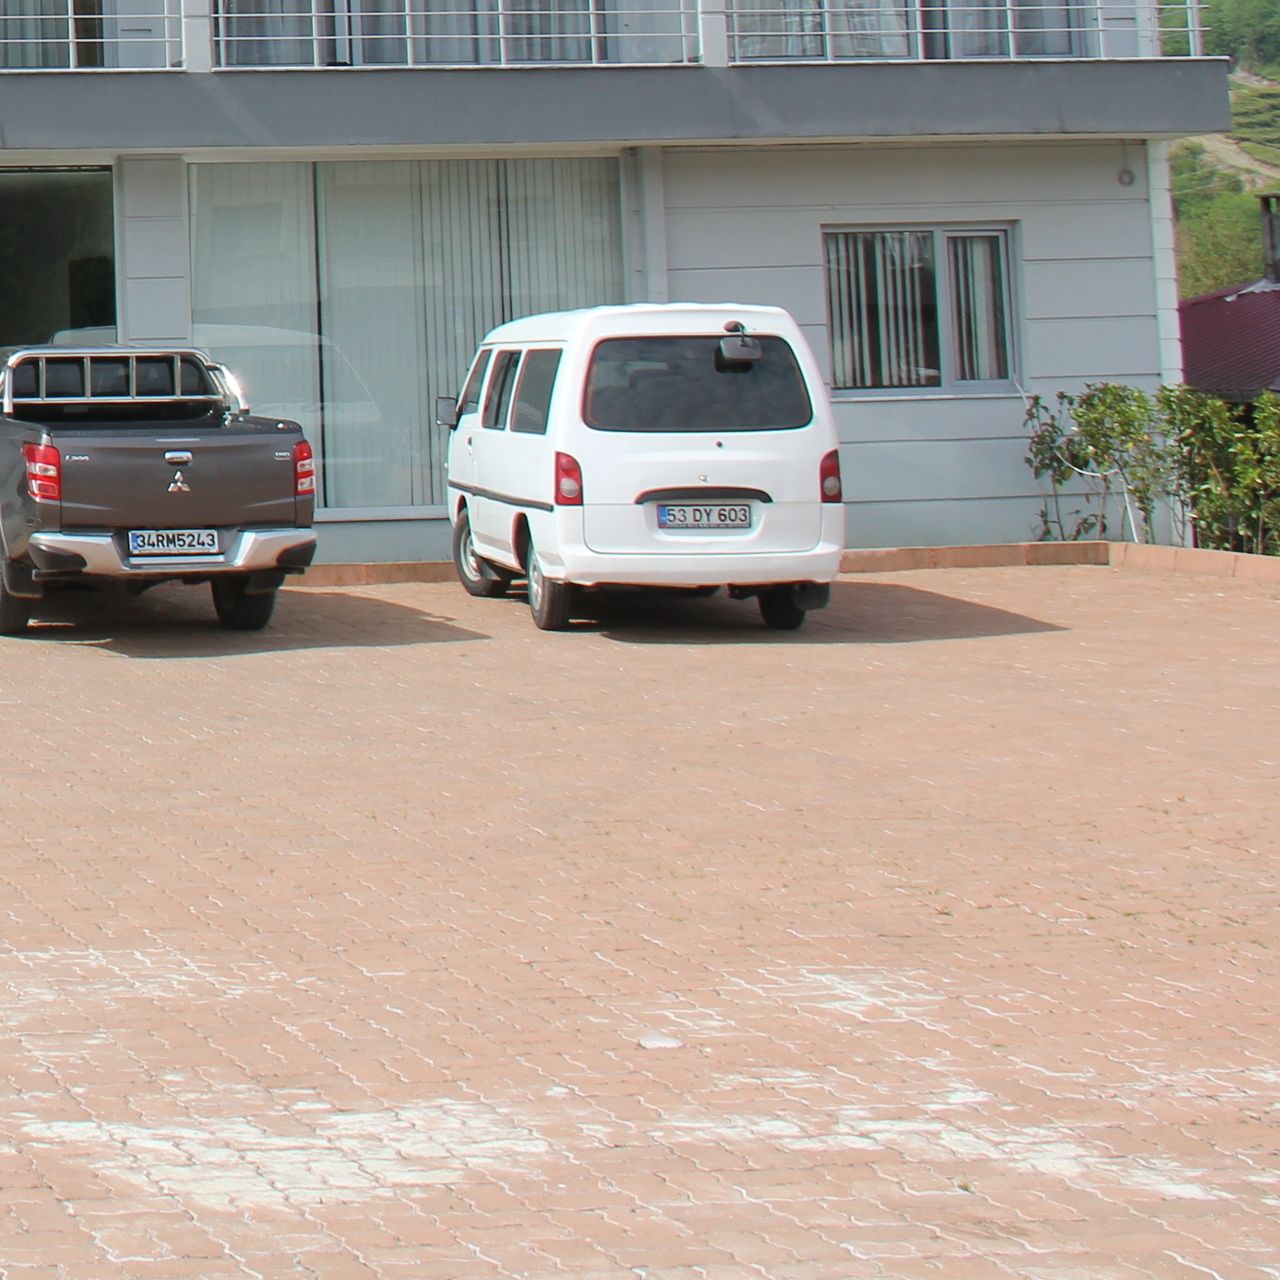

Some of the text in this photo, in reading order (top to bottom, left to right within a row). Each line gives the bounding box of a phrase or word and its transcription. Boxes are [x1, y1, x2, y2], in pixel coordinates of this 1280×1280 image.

[667, 508, 748, 522] 53 DY 603
